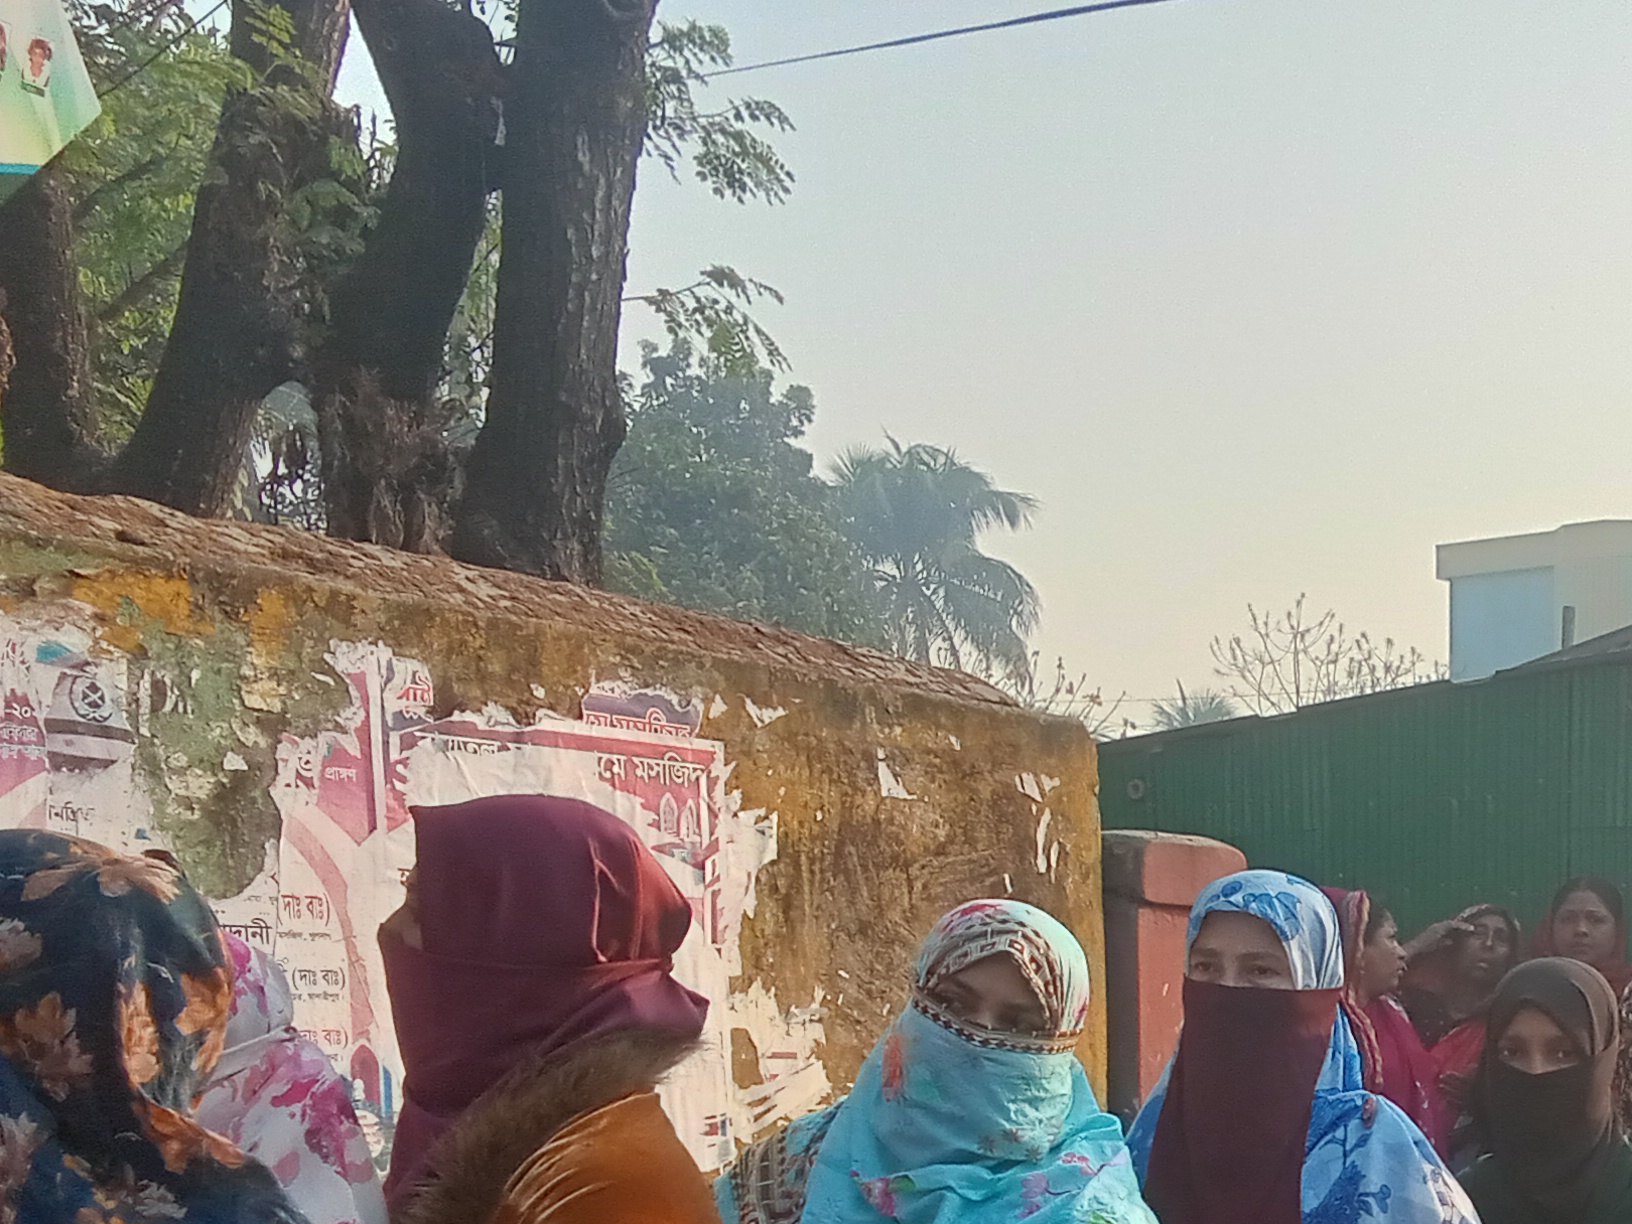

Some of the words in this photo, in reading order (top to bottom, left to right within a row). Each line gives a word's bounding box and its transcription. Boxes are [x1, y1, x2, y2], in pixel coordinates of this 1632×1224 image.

[631, 752, 707, 788] মসজিদ
[304, 893, 331, 927] বাঃ)
[219, 917, 273, 945] দানী
[292, 967, 318, 991] (দাঃ
[320, 967, 346, 991] বাঃ)
[321, 1027, 349, 1050] বাঃ)
